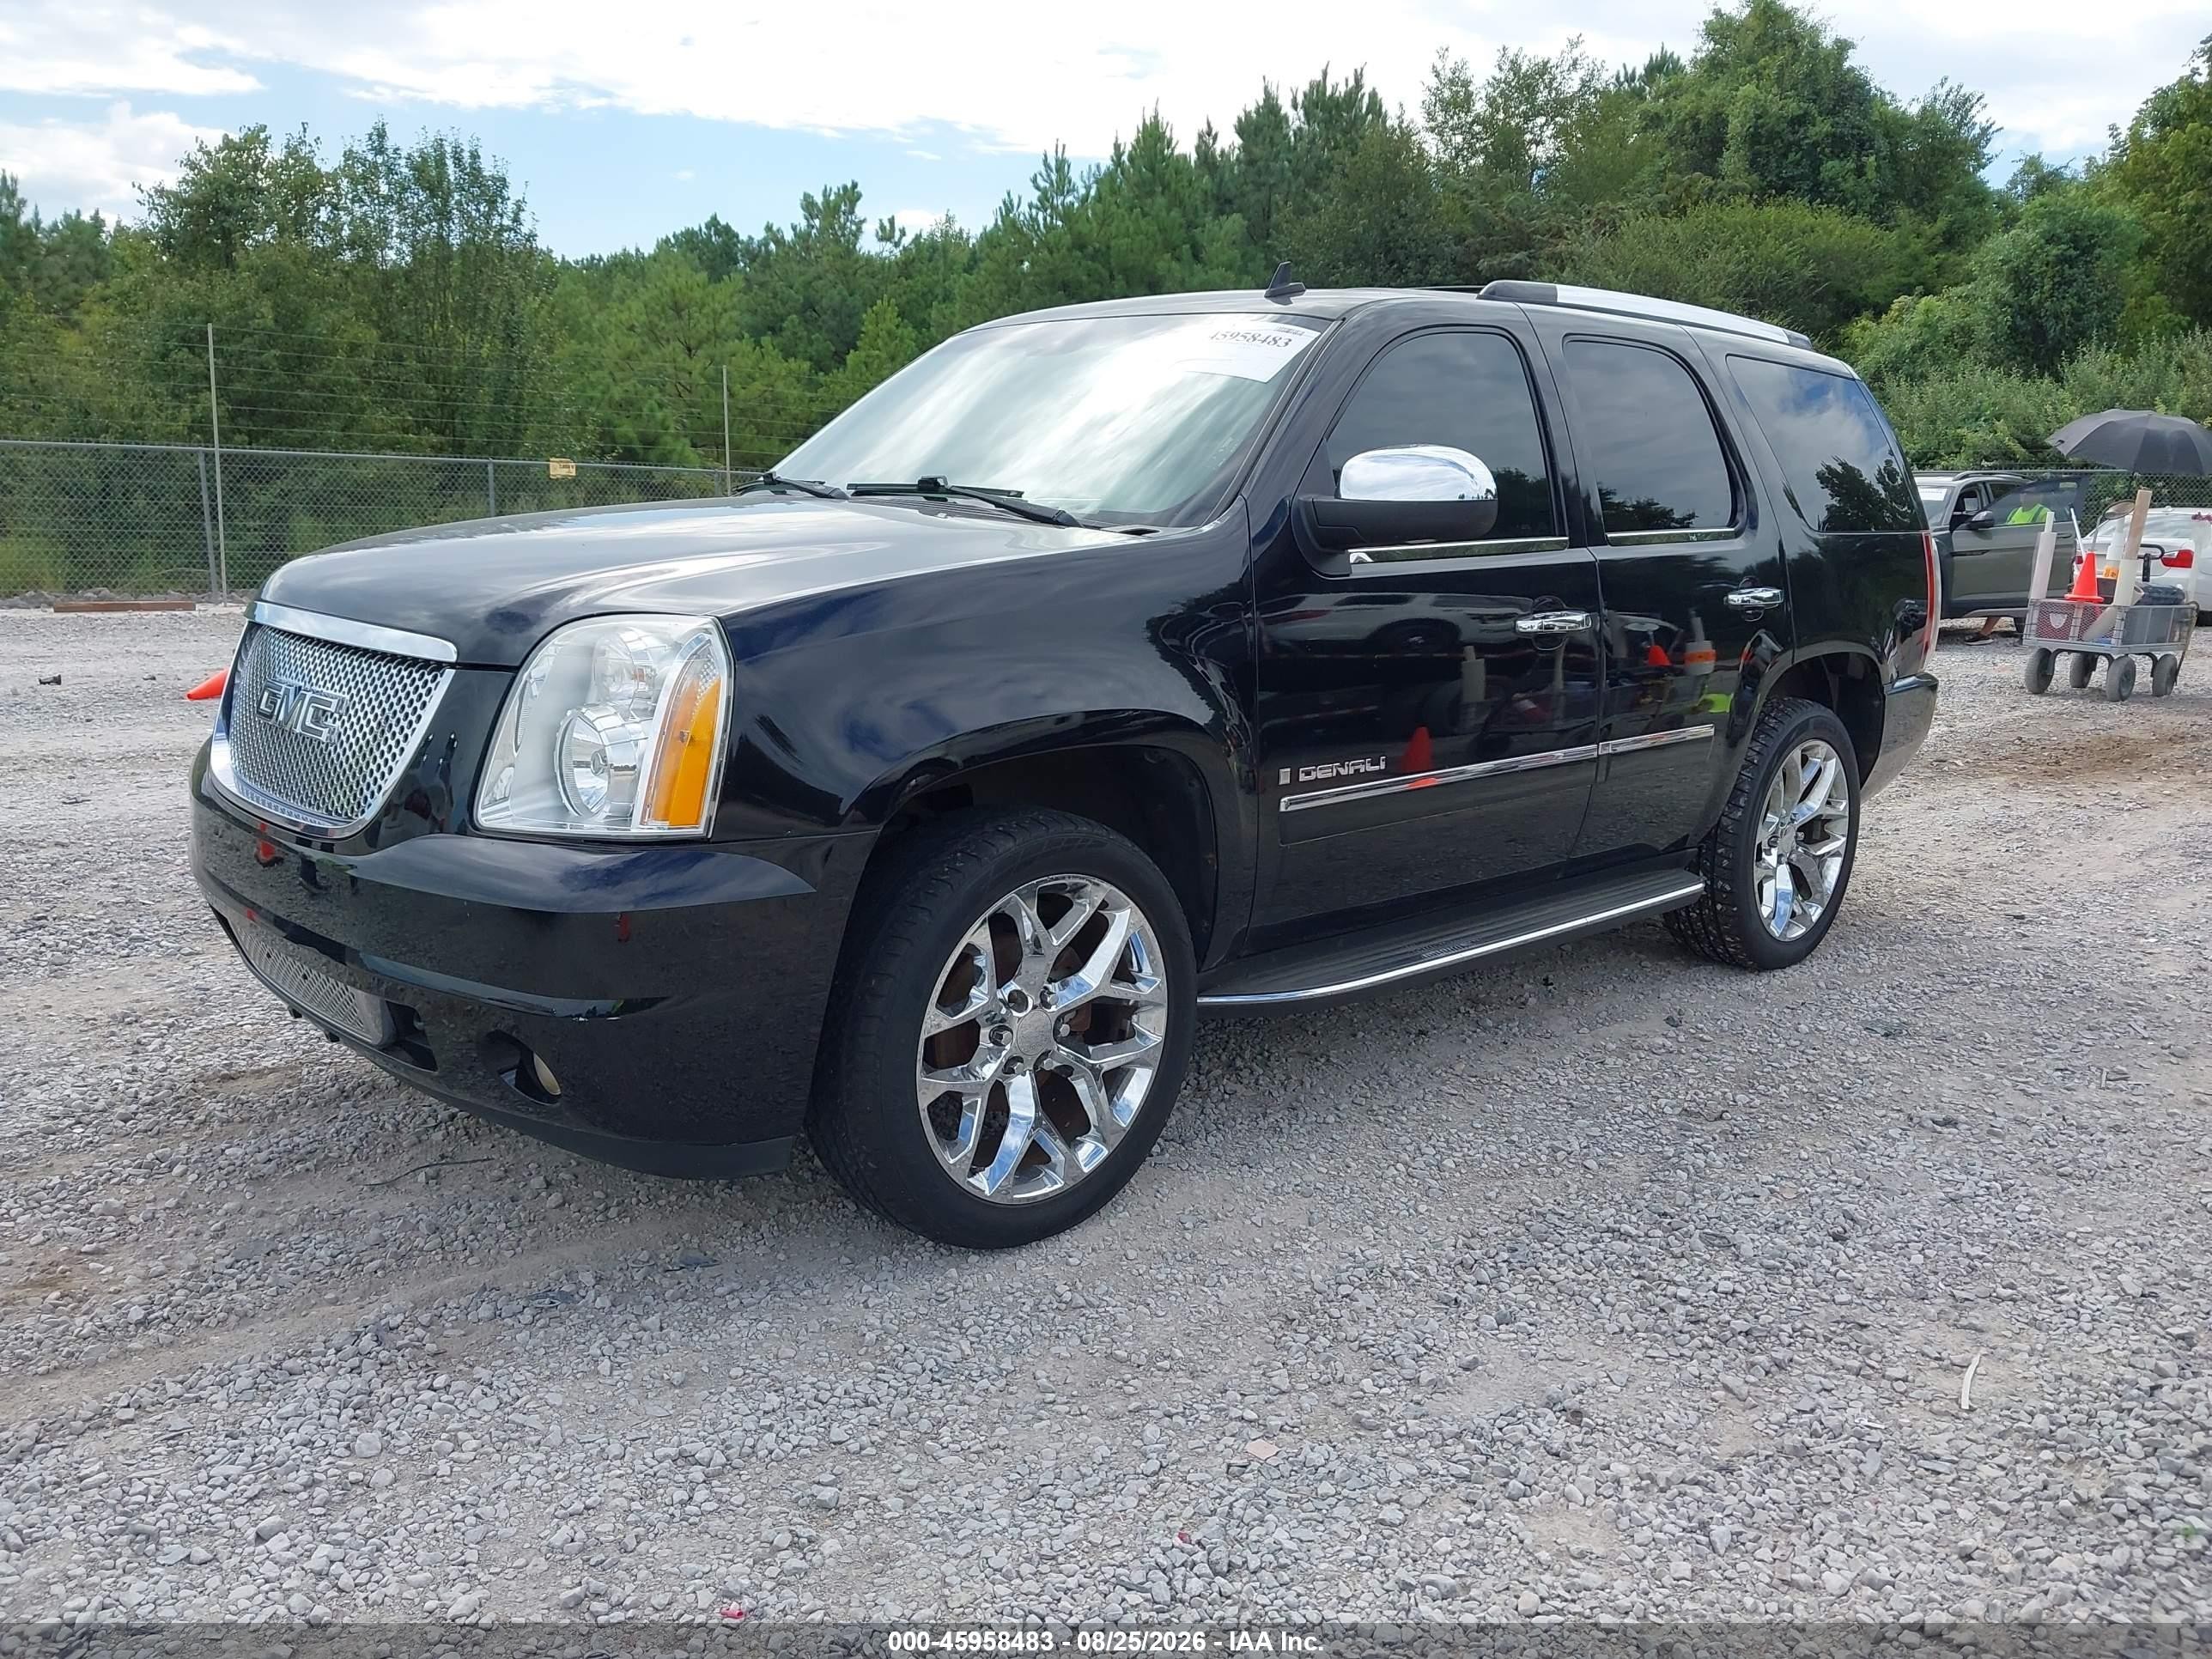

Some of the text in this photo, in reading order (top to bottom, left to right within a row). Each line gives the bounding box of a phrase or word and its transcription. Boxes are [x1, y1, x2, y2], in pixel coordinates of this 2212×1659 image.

[1209, 330, 1292, 348] 45958483
[257, 678, 345, 744] GMC
[1297, 756, 1387, 782] DENALI
